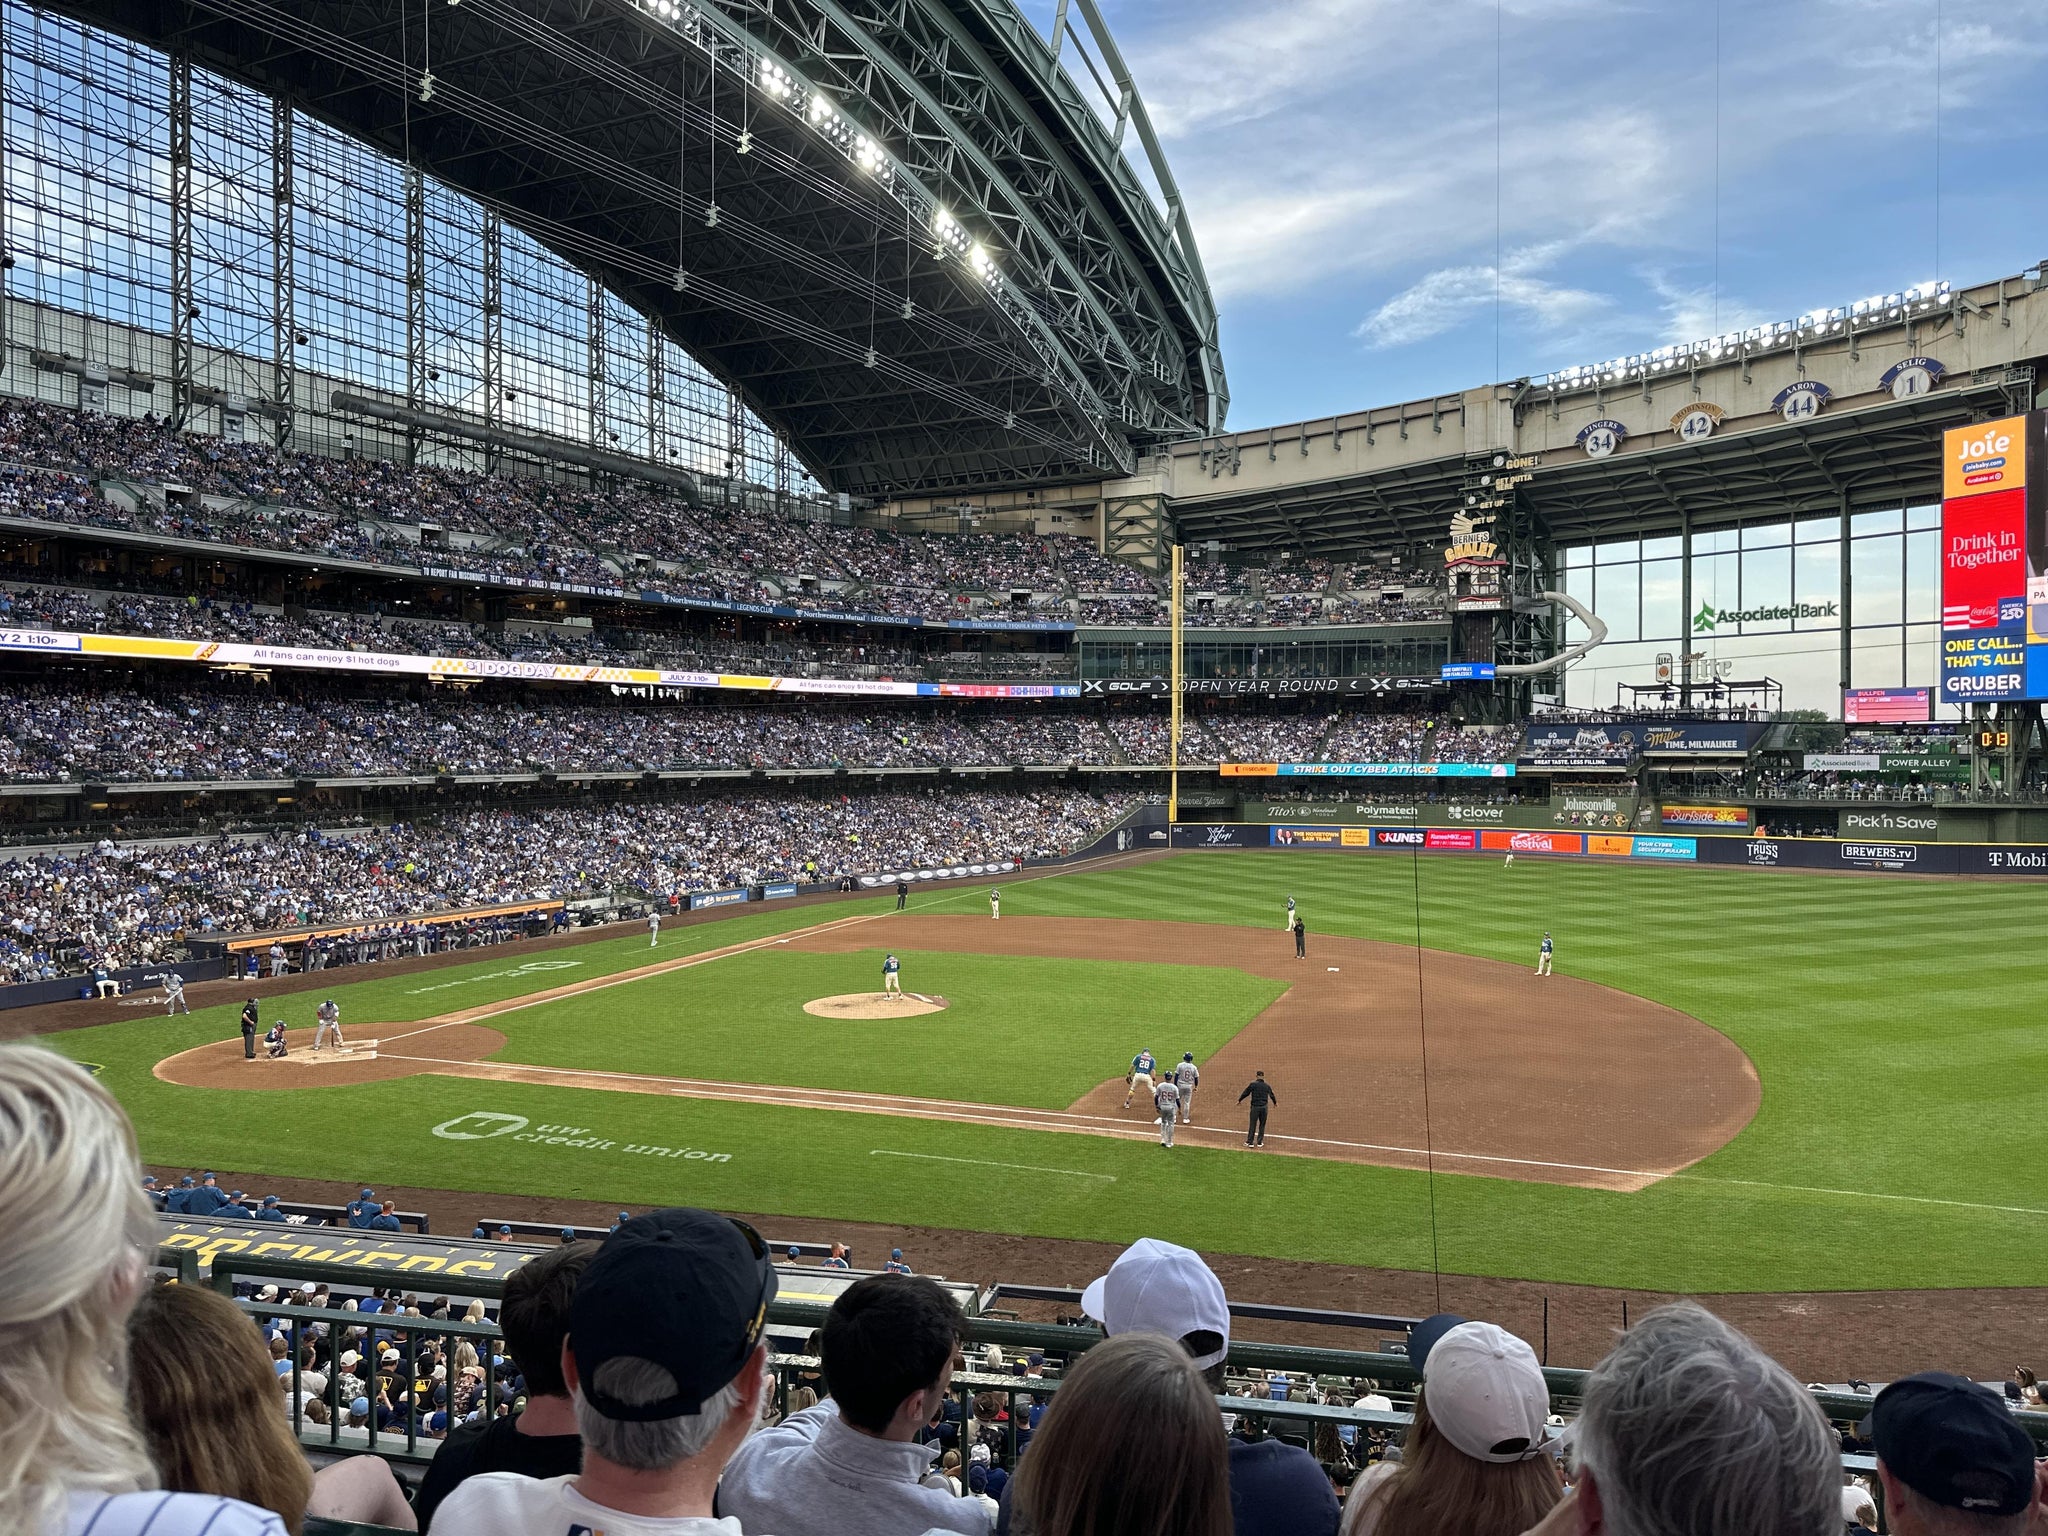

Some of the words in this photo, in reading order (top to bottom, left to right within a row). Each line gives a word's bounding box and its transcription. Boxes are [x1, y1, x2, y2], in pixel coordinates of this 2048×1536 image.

[91, 362, 104, 372] 430
[1896, 358, 1926, 372] SELIG
[1786, 382, 1816, 395] AARON
[1906, 375, 1918, 396] 1
[1676, 403, 1717, 421] ROBINSON
[1787, 396, 1814, 418] 44
[1584, 422, 1618, 435] FINGERS
[1683, 417, 1709, 437] 42
[1589, 433, 1612, 452] 34
[1958, 430, 2010, 460] Joie
[1506, 455, 1538, 470] GONE!
[1509, 473, 1532, 483] OUTTA
[1479, 501, 1493, 509] GET
[1486, 515, 1496, 523] UP
[1453, 532, 1489, 545] BERNIE'S
[1952, 531, 1997, 552] Drink
[2000, 530, 2015, 546] in
[1444, 542, 1497, 563] CHALET
[1947, 547, 2021, 569] Together
[431, 568, 448, 578] REPORT
[490, 574, 500, 583] TEXT
[670, 595, 711, 609] Northwestern
[711, 600, 732, 609] Mutual
[736, 603, 760, 613] LEGENDS
[761, 605, 773, 614] CLUB
[804, 610, 845, 621] Northwestern
[845, 613, 866, 621] Mutual
[871, 615, 895, 624] LEGENDS
[895, 616, 909, 625] CLUB
[12, 635, 21, 643] 2
[1945, 639, 1975, 653] ONE
[1977, 636, 2023, 649] CALL...
[254, 649, 267, 658] All
[270, 651, 293, 660] fans
[296, 653, 314, 661] can
[317, 654, 343, 664] enjoy
[346, 655, 356, 663] $1
[358, 656, 374, 665] hot
[377, 658, 400, 667] dogs
[1945, 655, 1991, 668] THAT'S
[1993, 652, 2024, 666] ALL!
[484, 662, 522, 677] DOG
[522, 664, 557, 678] DAY
[668, 674, 685, 682] JULY
[1946, 674, 2021, 692] GRUBER
[1060, 687, 1078, 696] 8:00
[1109, 682, 1151, 691] GOLF
[1177, 680, 1221, 692] OPEN
[1228, 680, 1270, 692] YEAR
[1279, 679, 1339, 692] ROUND
[1644, 730, 1685, 748] Miller
[1665, 741, 1688, 750] TIME,
[1689, 740, 1738, 749] MILWAUKEE
[1982, 732, 2008, 747] 0:13
[1293, 766, 1328, 774] STRIKE
[1331, 766, 1353, 774] OUT
[1355, 766, 1388, 774] CYBER
[1390, 766, 1438, 774] ATTACKS
[1886, 759, 1920, 767] POWER
[1921, 759, 1951, 768] ALLEY
[1267, 806, 1296, 817] Tito's
[1356, 805, 1418, 816] Polymatech
[1463, 806, 1504, 818] clover
[1563, 798, 1617, 812] Johnsonville
[1671, 808, 1713, 823] Surfside
[1847, 814, 1879, 829] Pick
[1896, 815, 1938, 829] Save
[1385, 832, 1424, 843] KUNES
[1510, 836, 1552, 850] festival
[1746, 844, 1778, 859] TRUSS
[1846, 846, 1912, 859] BREWERS.TV
[1139, 1060, 1150, 1069] 28
[1184, 1070, 1190, 1080] 6
[1161, 1091, 1174, 1100] 65
[535, 1124, 592, 1137] uw
[512, 1131, 617, 1151] credit
[622, 1146, 733, 1163] union
[342, 1239, 395, 1249] OF
